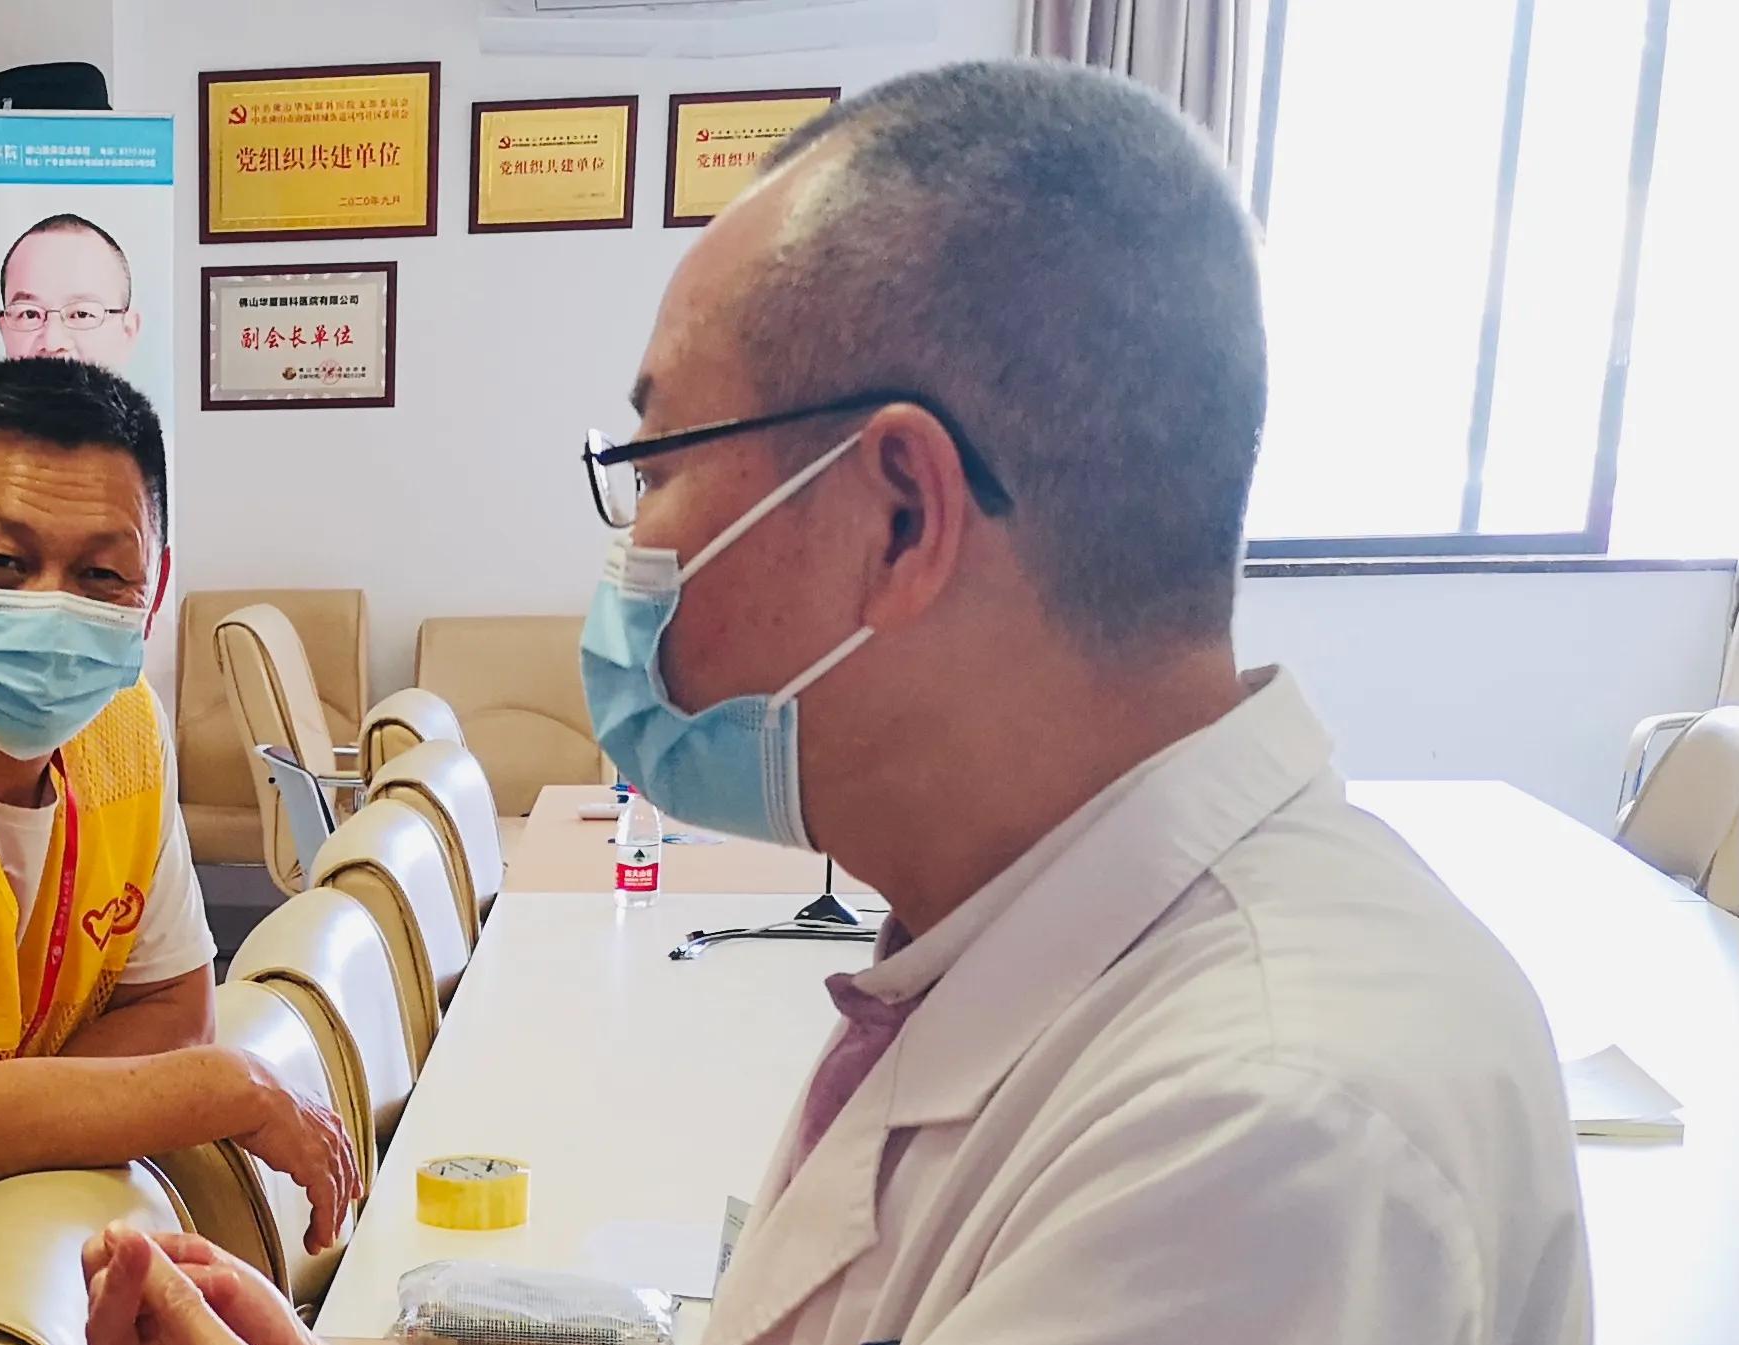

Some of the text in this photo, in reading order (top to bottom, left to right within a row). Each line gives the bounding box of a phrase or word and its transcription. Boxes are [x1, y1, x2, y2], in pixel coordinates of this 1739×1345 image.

[236, 141, 401, 173] 党组织共建单位
[499, 156, 605, 176] 党组织共建单位
[697, 151, 765, 168] 党组织共
[240, 324, 354, 351] 副会长单位
